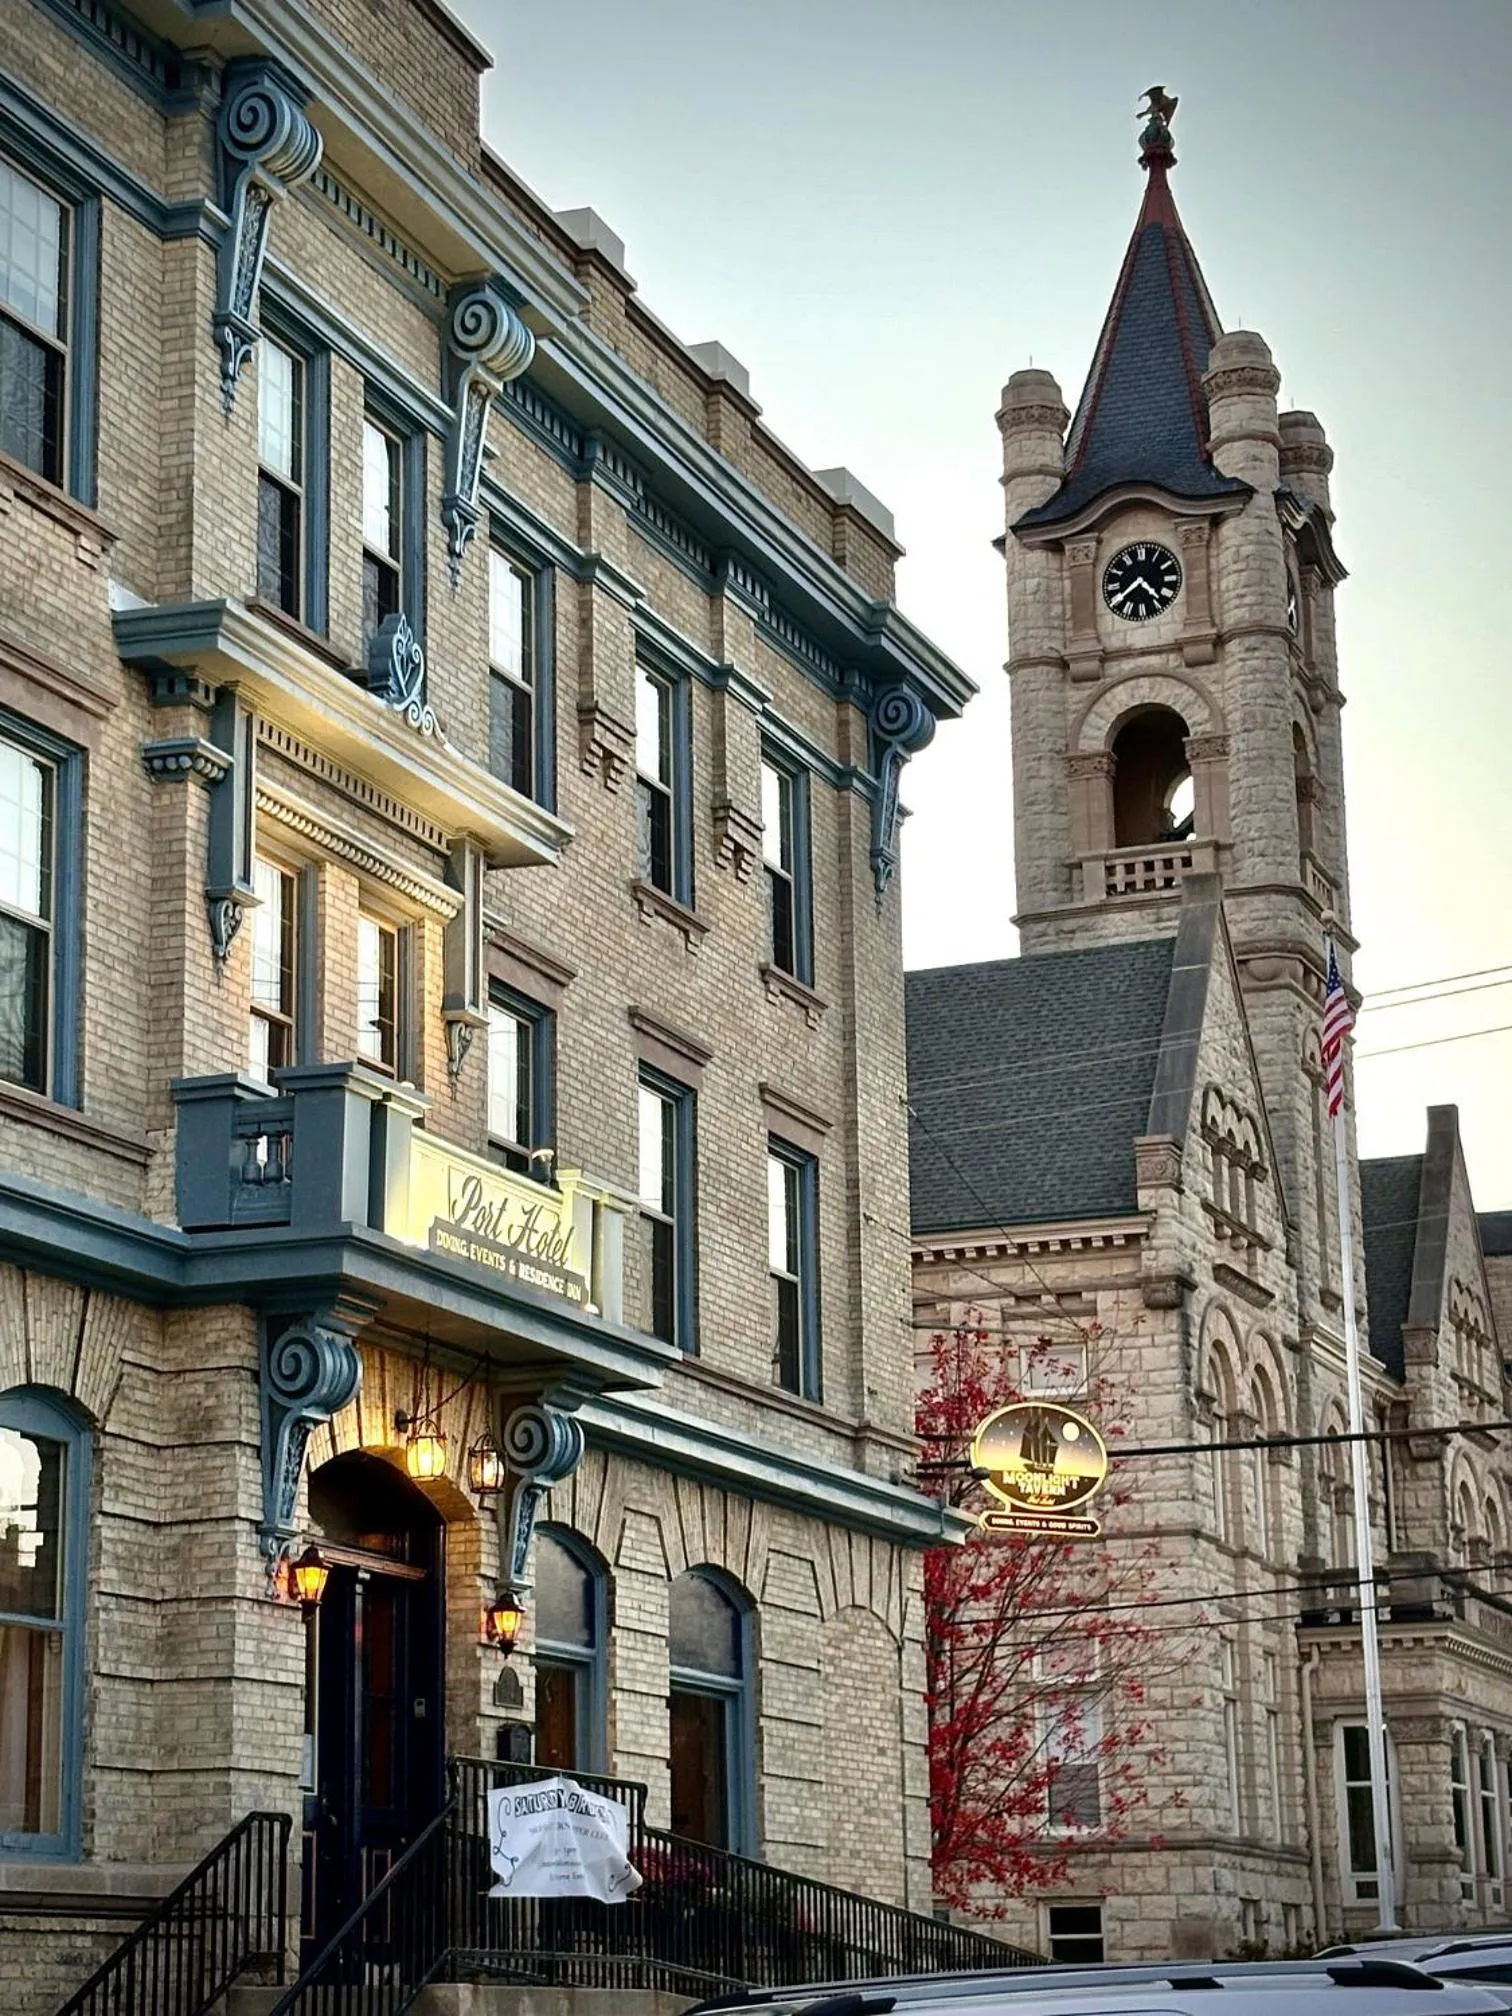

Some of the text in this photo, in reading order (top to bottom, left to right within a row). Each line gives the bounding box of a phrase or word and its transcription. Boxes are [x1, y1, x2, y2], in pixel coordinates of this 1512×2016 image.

[452, 1175, 575, 1265] Port Hotel
[470, 1243, 506, 1271] EVENTS
[509, 1259, 516, 1276] &
[519, 1262, 565, 1295] RESIDENCE
[567, 1281, 582, 1302] INN
[1003, 1471, 1080, 1490] MOONLIGHT
[1018, 1481, 1066, 1497] TAVERN
